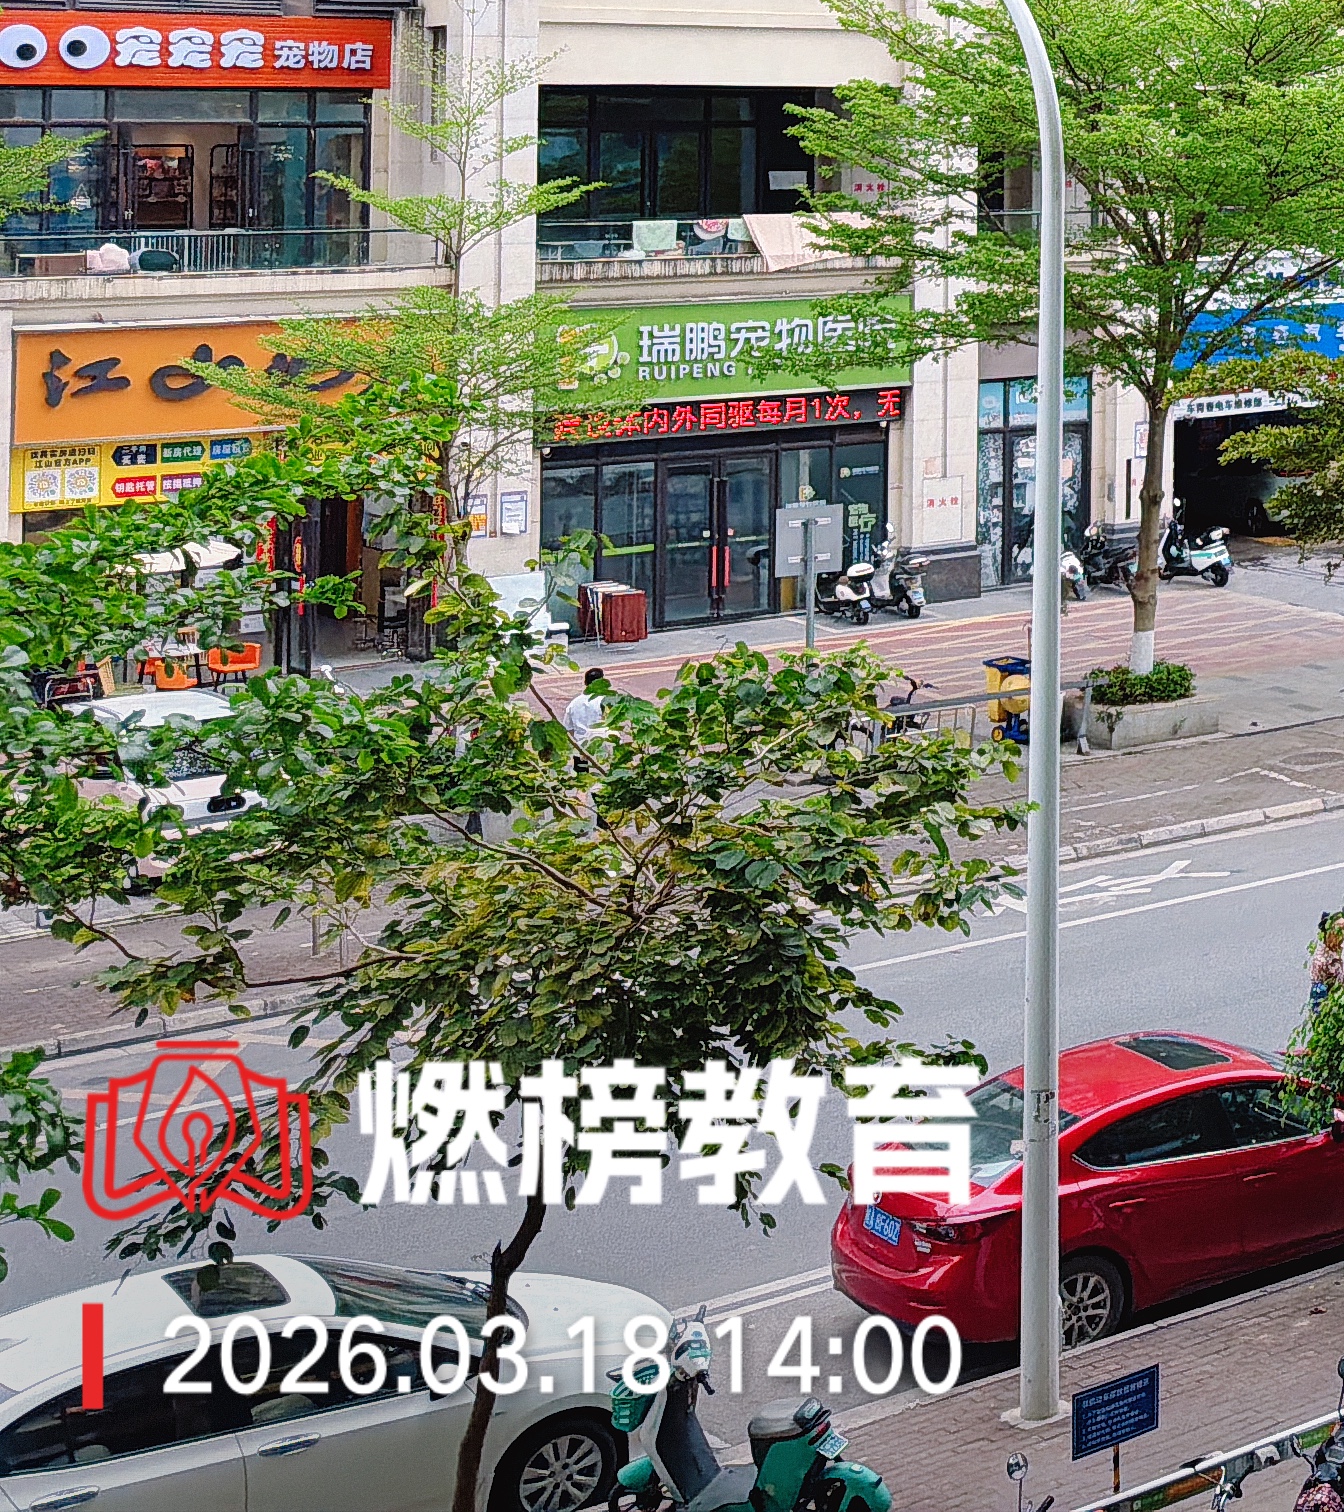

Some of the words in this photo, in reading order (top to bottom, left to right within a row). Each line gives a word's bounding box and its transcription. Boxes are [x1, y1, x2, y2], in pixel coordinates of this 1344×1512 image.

[273, 40, 374, 71] 宠物店
[638, 360, 737, 382] RUIPENG
